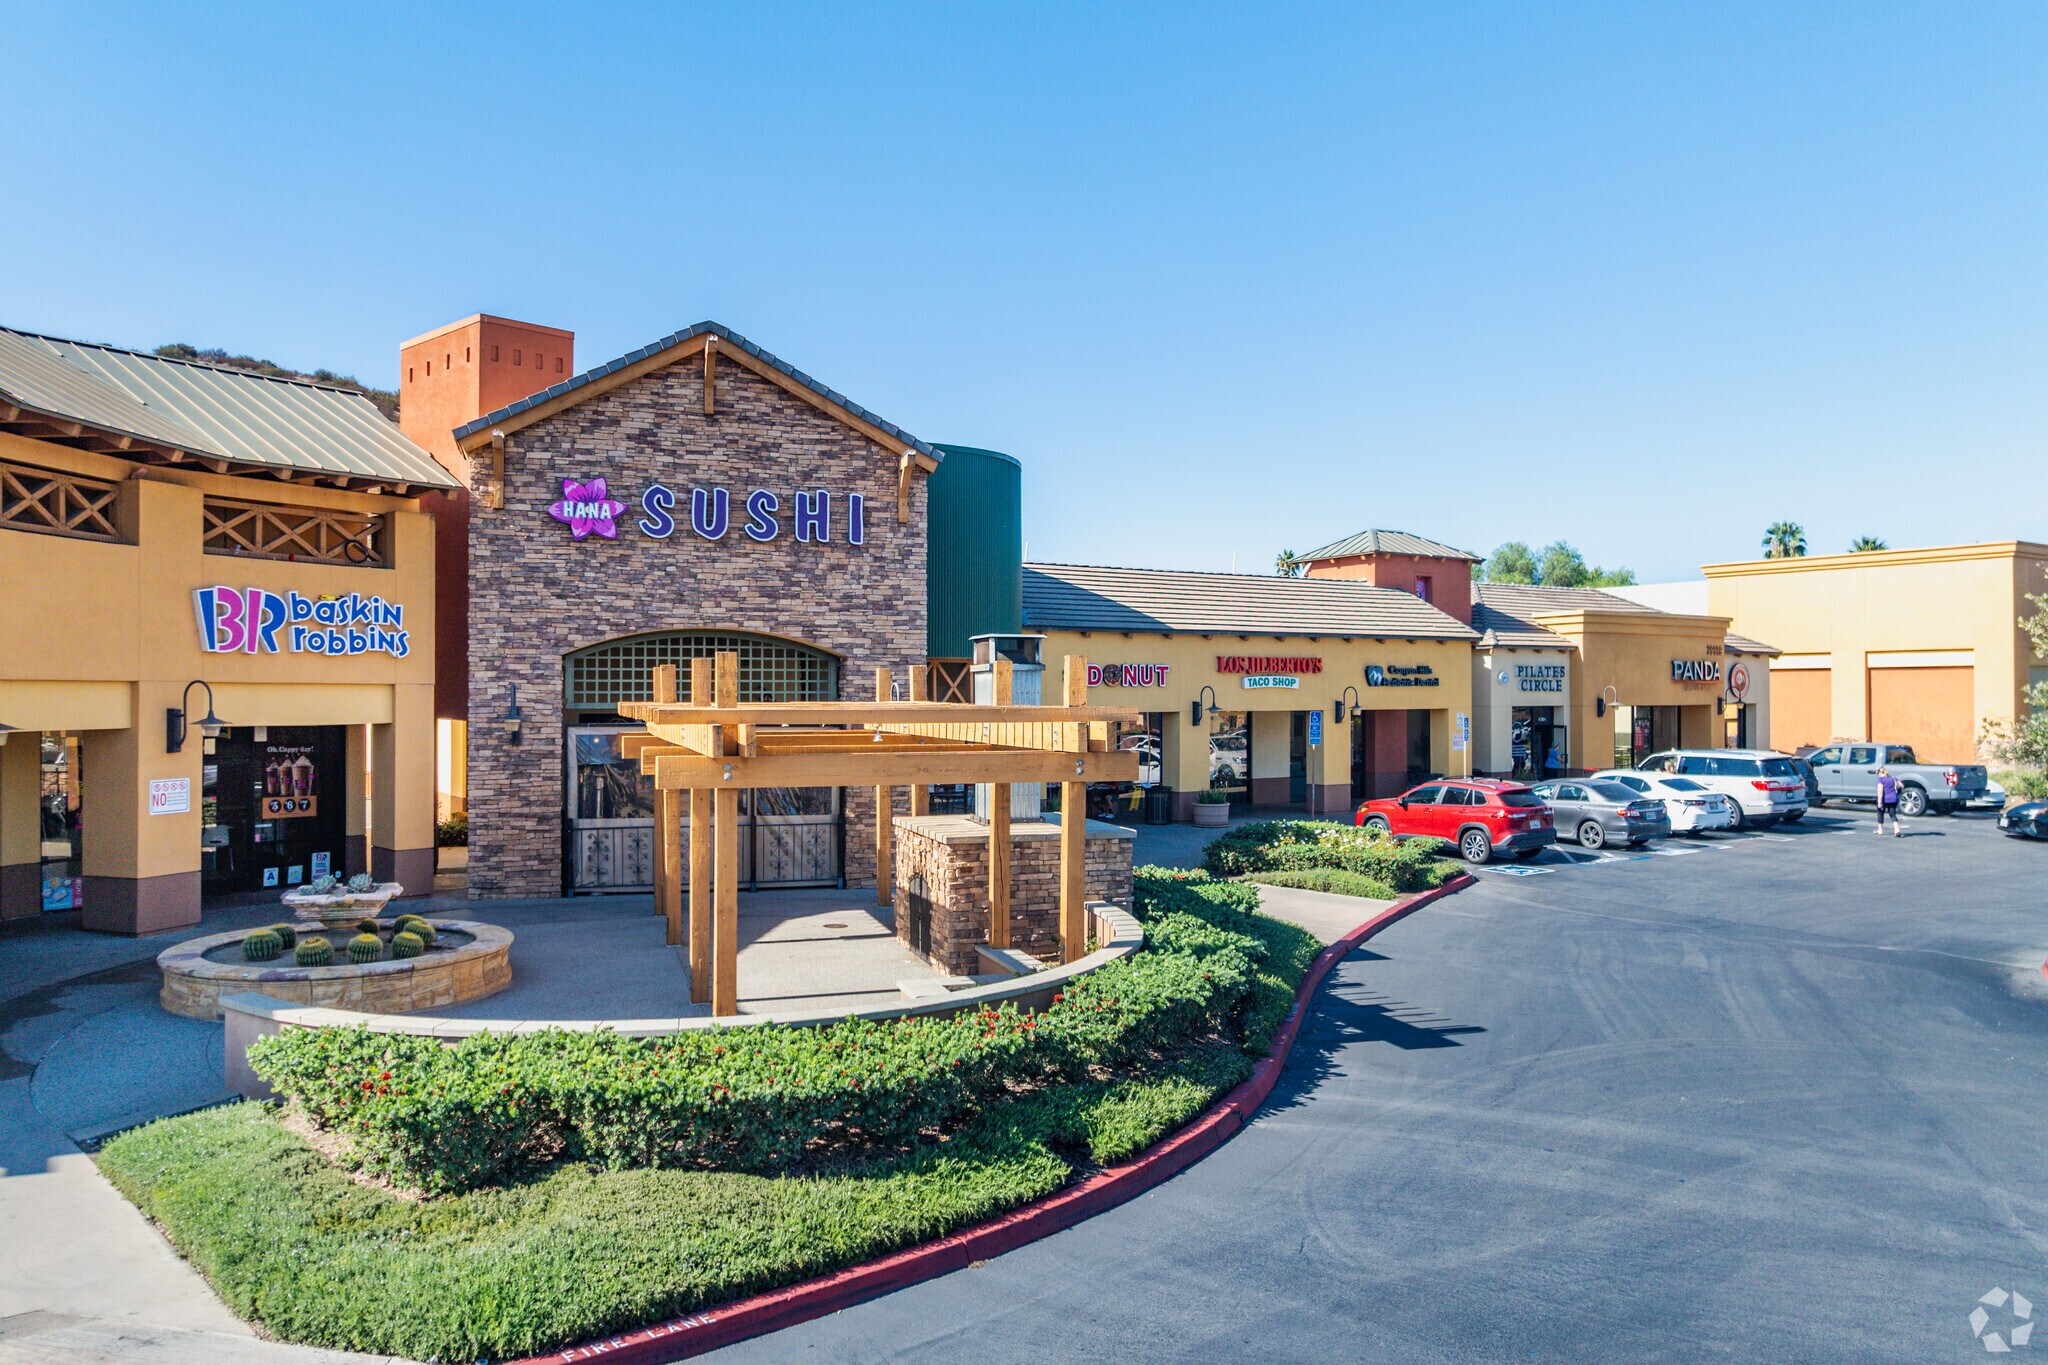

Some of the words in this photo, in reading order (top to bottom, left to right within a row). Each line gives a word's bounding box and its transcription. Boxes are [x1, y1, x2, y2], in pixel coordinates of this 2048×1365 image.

[562, 500, 612, 520] HANA
[638, 484, 864, 545] SUSHI
[194, 585, 287, 654] BR
[286, 590, 404, 630] baskin
[289, 624, 411, 659] robbins
[1087, 664, 1170, 687] DONUT
[1216, 656, 1246, 673] LOS
[1247, 656, 1323, 674] JILBERTO'S
[1516, 665, 1566, 677] PILATES
[1672, 660, 1720, 681] PANDA
[1247, 677, 1270, 687] TACO
[1272, 676, 1296, 687] SHOP
[1520, 680, 1562, 692] CIRCLE
[152, 792, 167, 807] NO
[267, 872, 275, 880] A
[560, 1336, 629, 1363] FIRE
[645, 1312, 717, 1338] LANE
